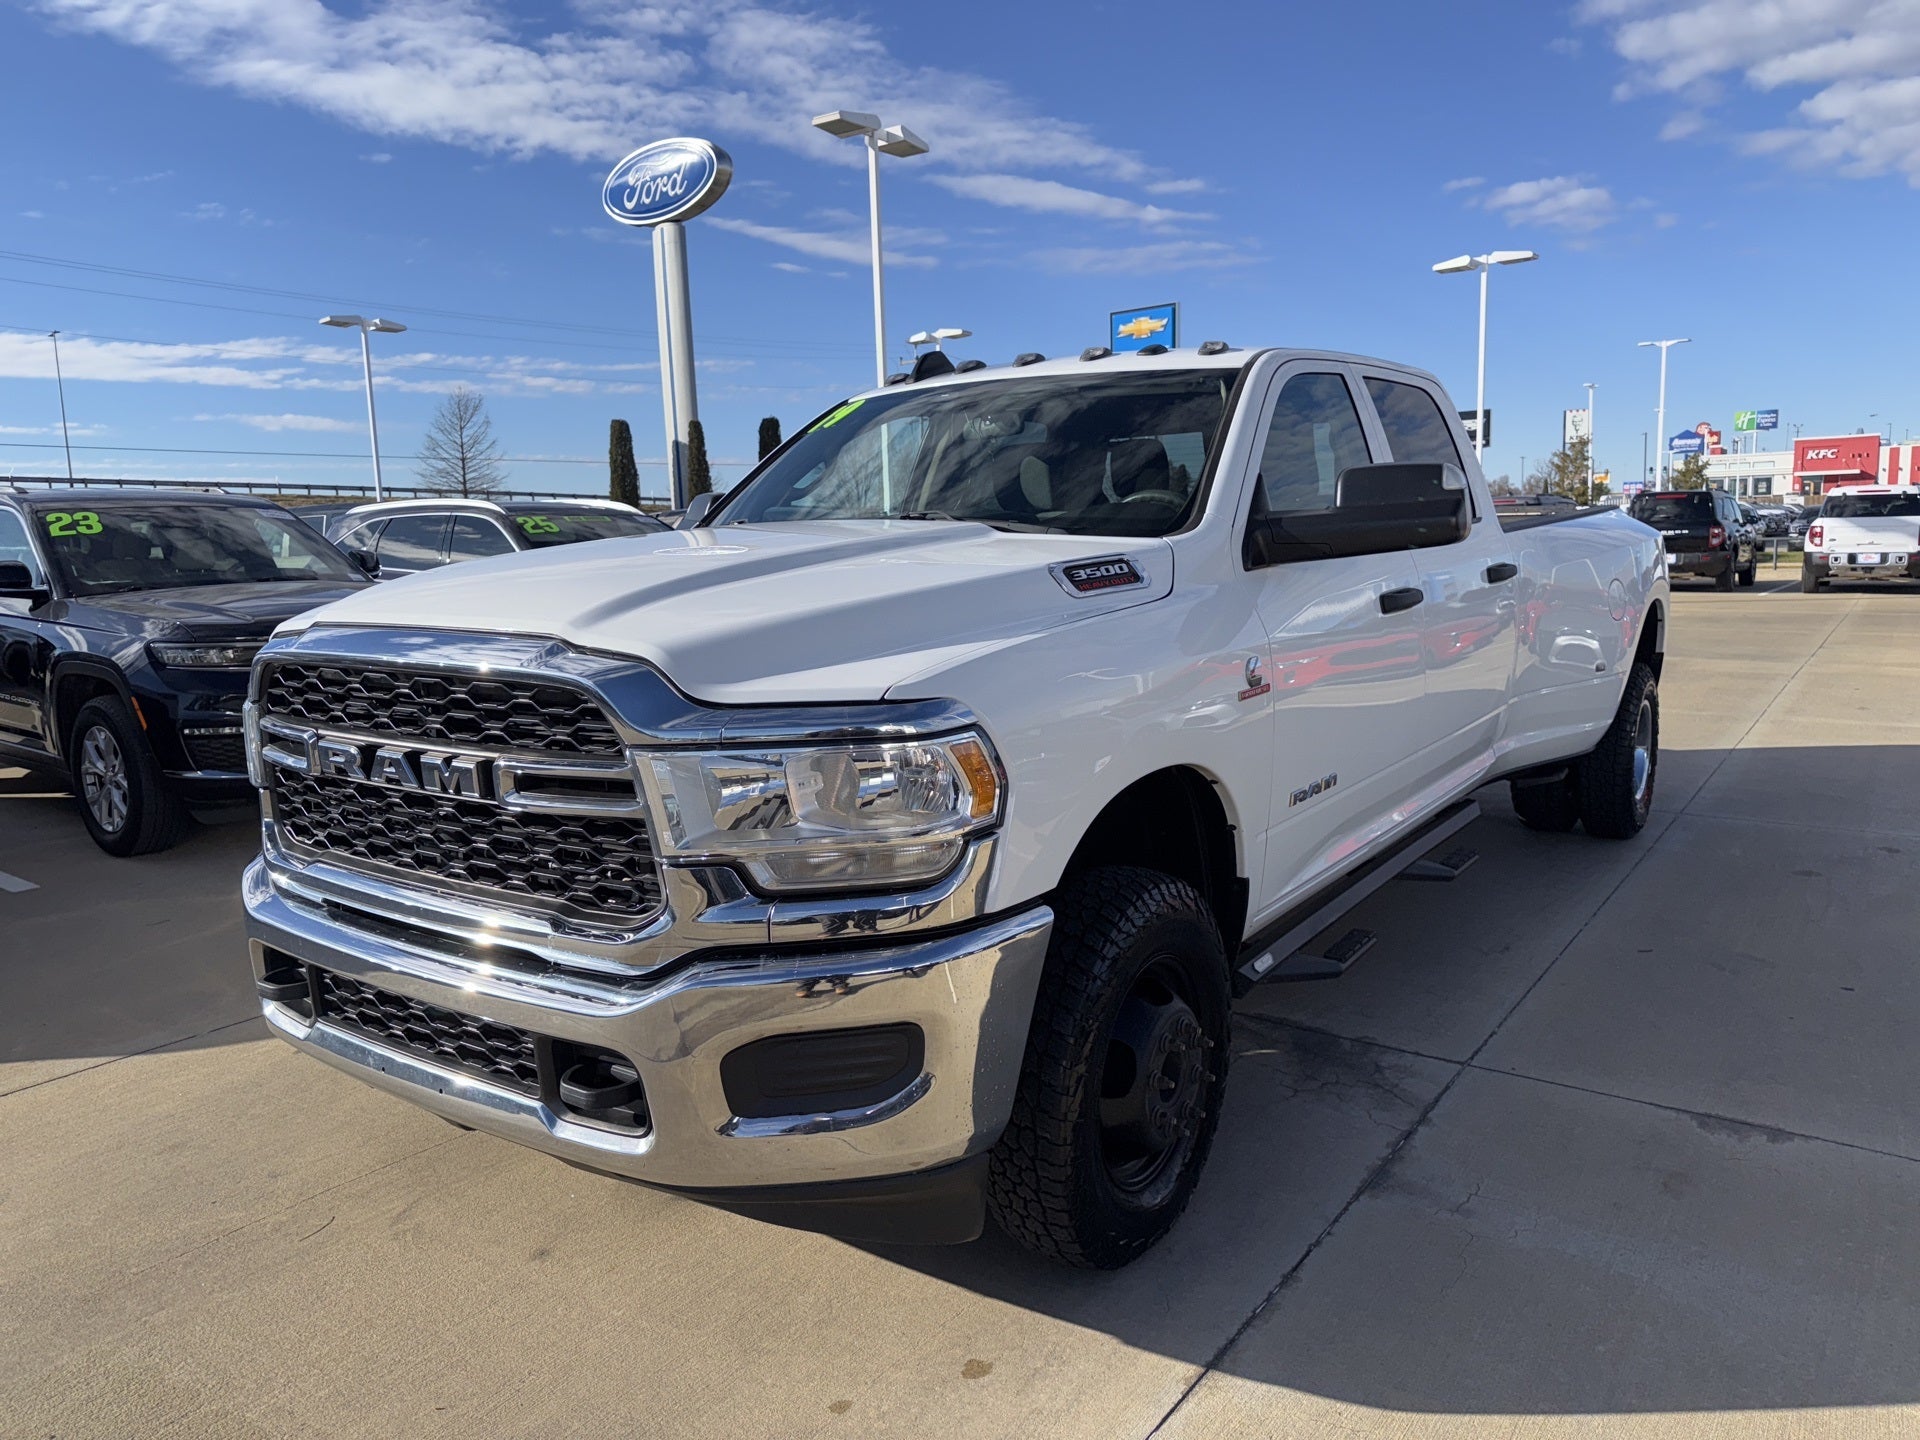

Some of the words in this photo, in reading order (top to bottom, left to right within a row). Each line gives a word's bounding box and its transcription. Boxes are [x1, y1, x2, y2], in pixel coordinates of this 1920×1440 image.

[624, 156, 688, 210] Ford
[1806, 448, 1838, 459] KFC
[46, 511, 103, 537] 23
[516, 516, 560, 534] 25
[1070, 563, 1129, 581] 3500
[1079, 581, 1109, 591] HEAVY
[1111, 576, 1134, 585] DUTY
[317, 738, 480, 798] RAM
[1288, 772, 1337, 807] RAM
